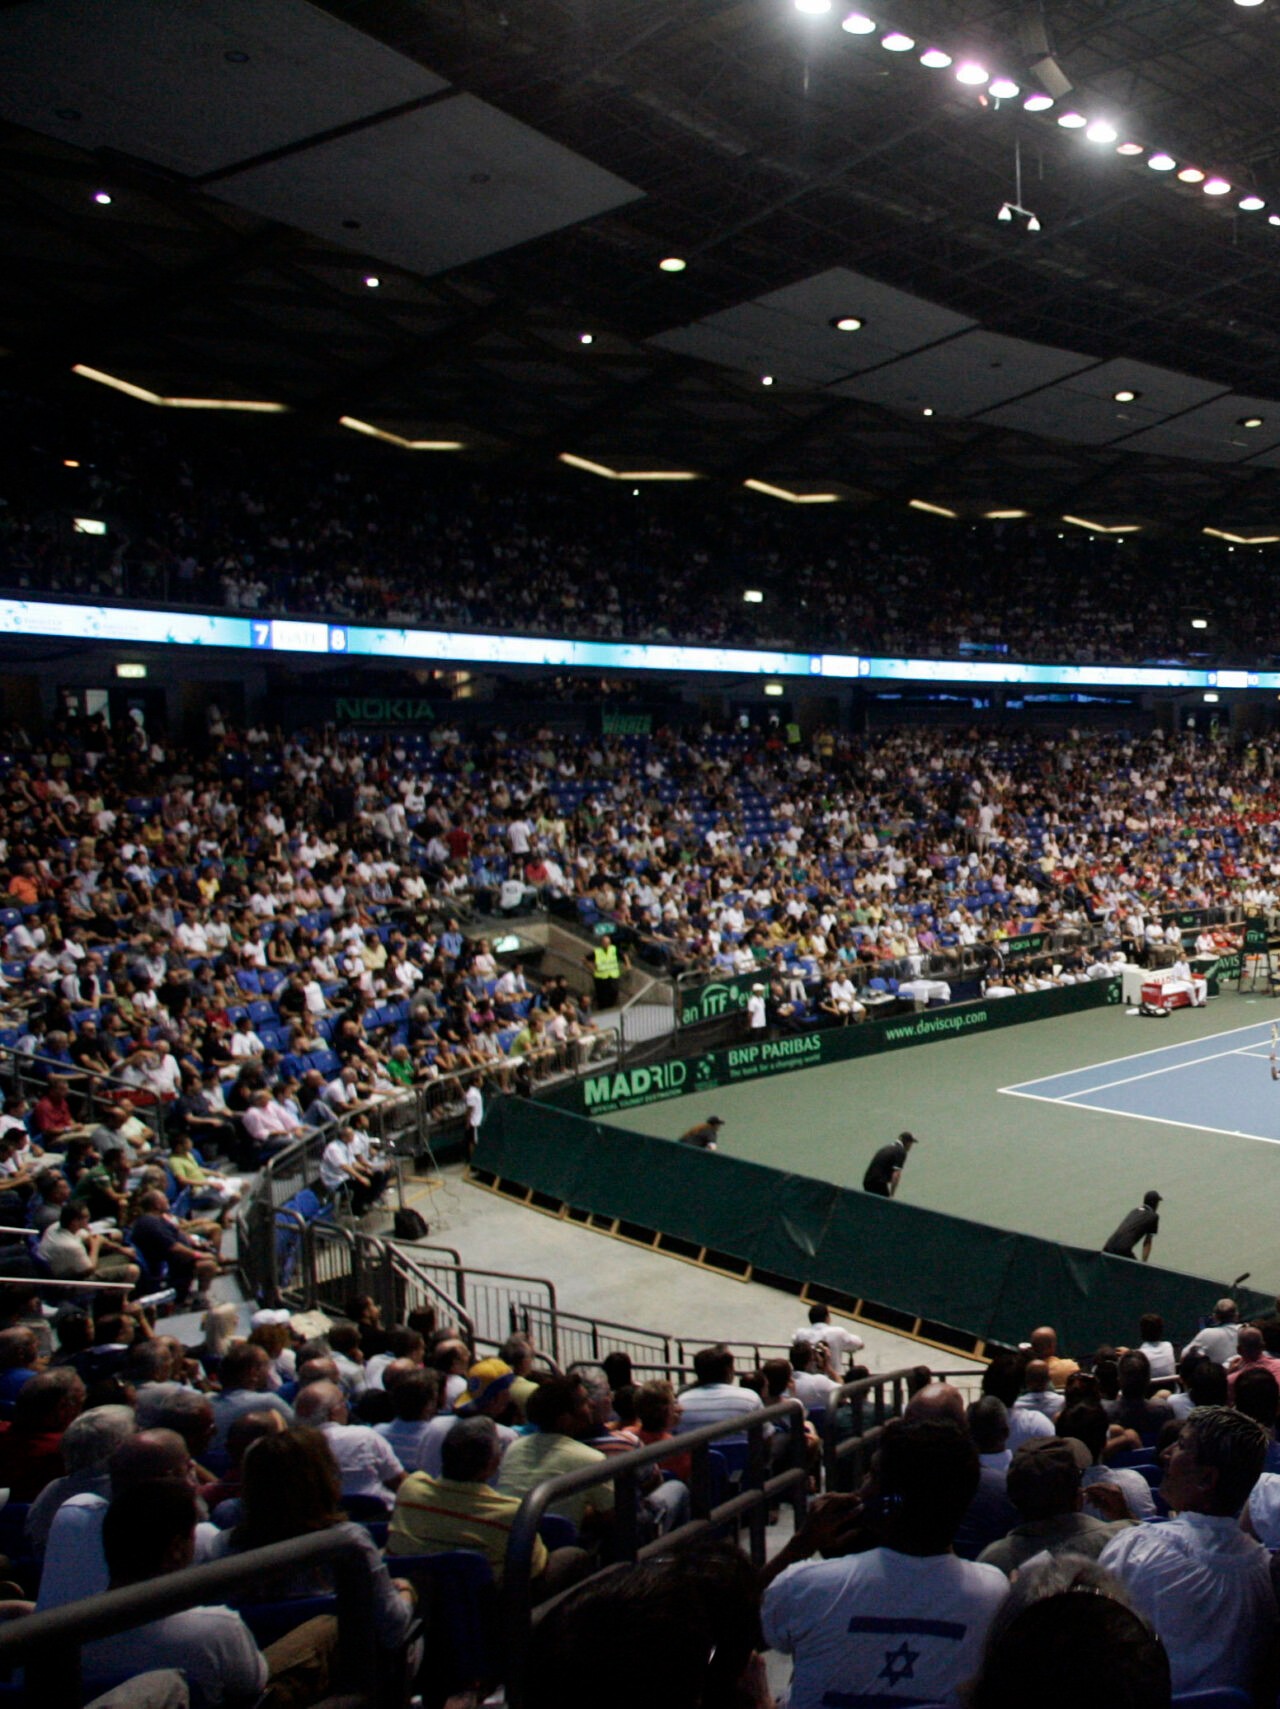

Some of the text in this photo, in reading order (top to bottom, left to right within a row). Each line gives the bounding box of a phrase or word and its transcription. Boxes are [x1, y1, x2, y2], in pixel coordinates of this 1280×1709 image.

[255, 625, 269, 645] 7
[331, 629, 345, 650] 8
[335, 698, 435, 720] NOKIA
[682, 1006, 698, 1024] an
[703, 991, 728, 1018] ITF
[886, 1010, 988, 1040] www.daviscup.com
[728, 1035, 822, 1067] BNP PARIBAS
[584, 1060, 687, 1106] MADRID
